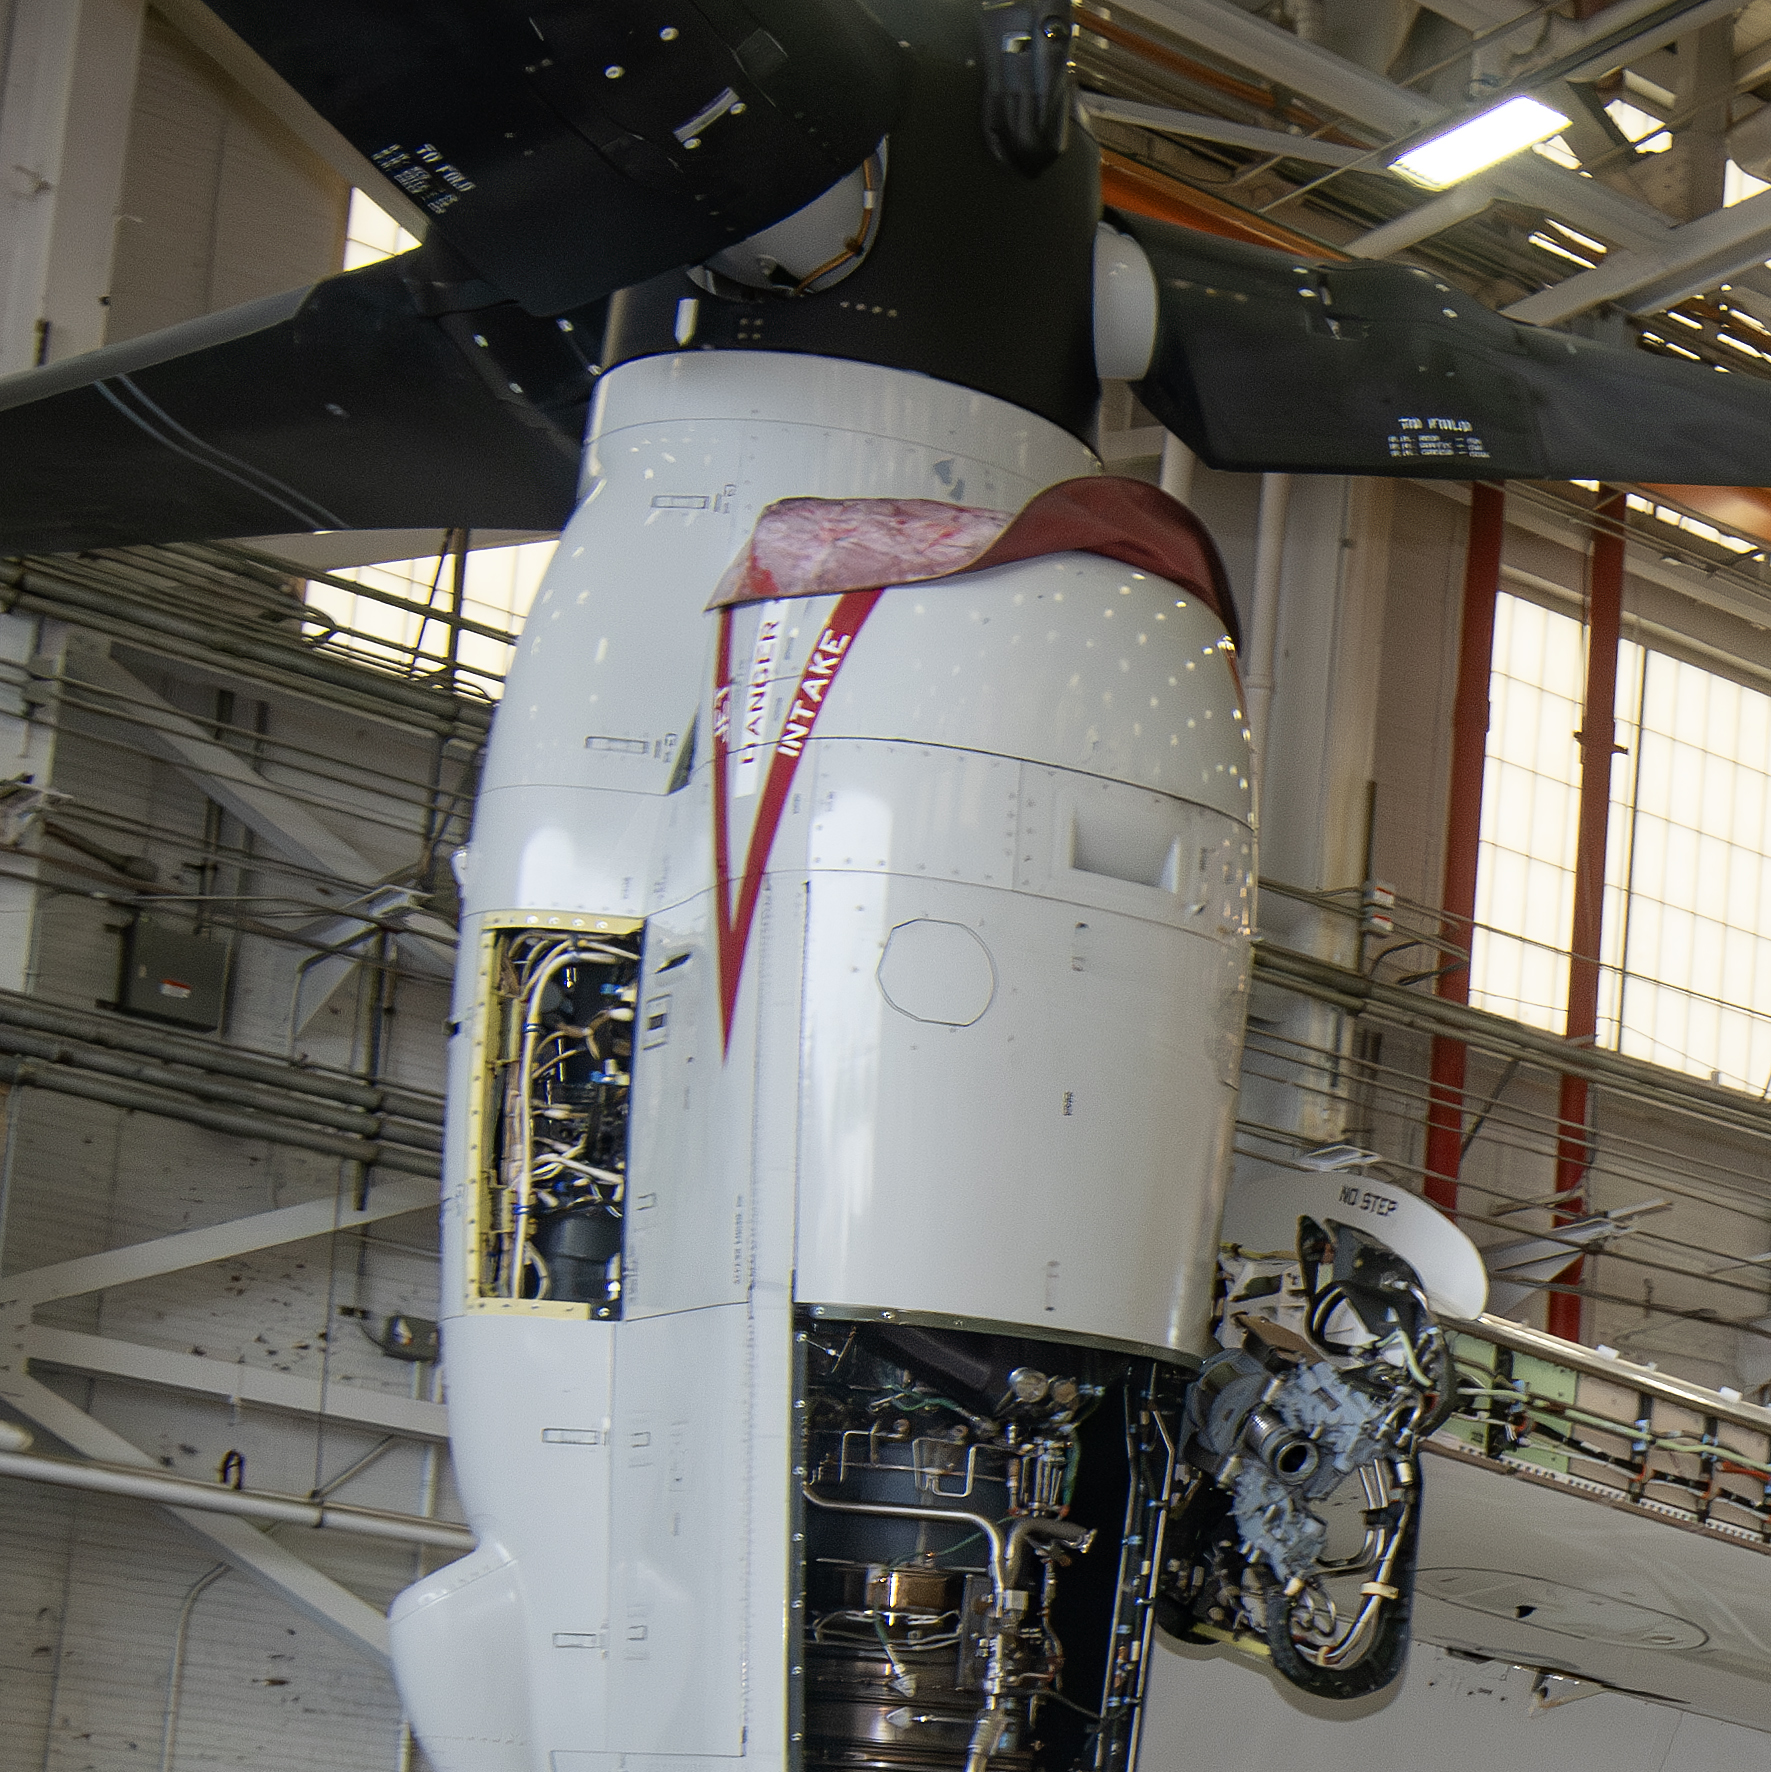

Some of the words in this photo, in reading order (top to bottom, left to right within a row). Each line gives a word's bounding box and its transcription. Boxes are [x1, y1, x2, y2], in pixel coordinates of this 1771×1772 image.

[740, 620, 780, 765] DANGER
[776, 628, 852, 758] INTAKE
[1339, 1186, 1359, 1206] NO
[1360, 1192, 1398, 1217] STEP
